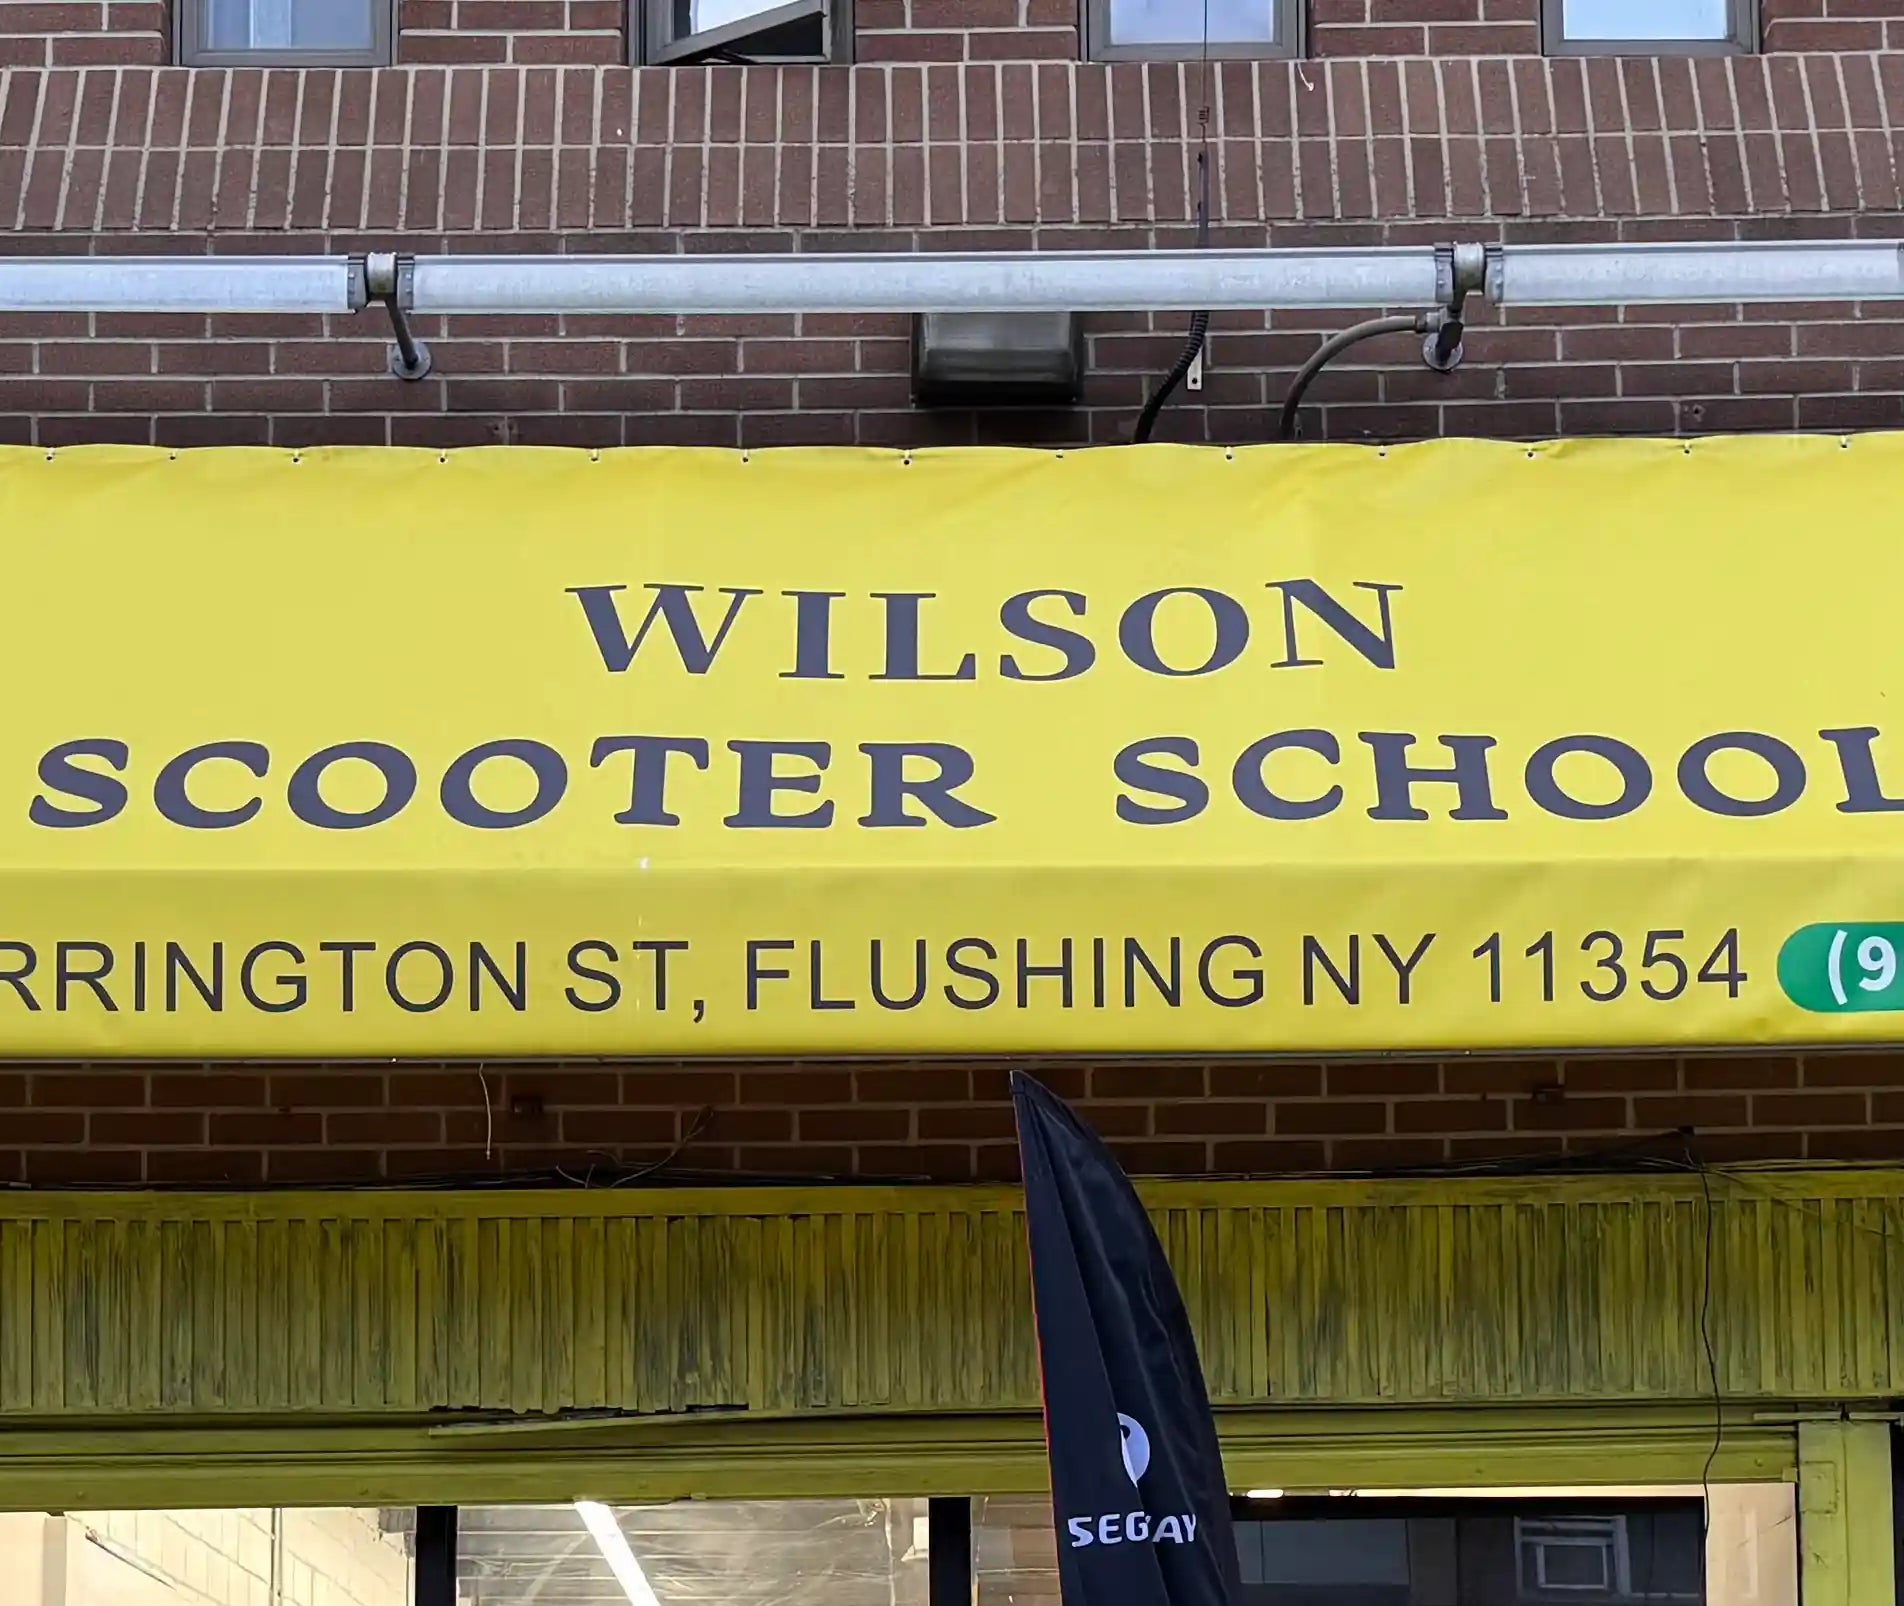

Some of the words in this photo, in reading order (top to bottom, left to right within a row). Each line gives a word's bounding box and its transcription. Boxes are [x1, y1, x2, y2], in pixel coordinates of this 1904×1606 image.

[565, 579, 1403, 681] WILSON
[29, 736, 997, 829] SCOOTER
[565, 940, 704, 1023] ST,
[747, 935, 1263, 1010] FLUSHING
[1303, 933, 1436, 1005] NY
[1473, 928, 1747, 1002] 11354
[1067, 1511, 1197, 1548] SEGAY
